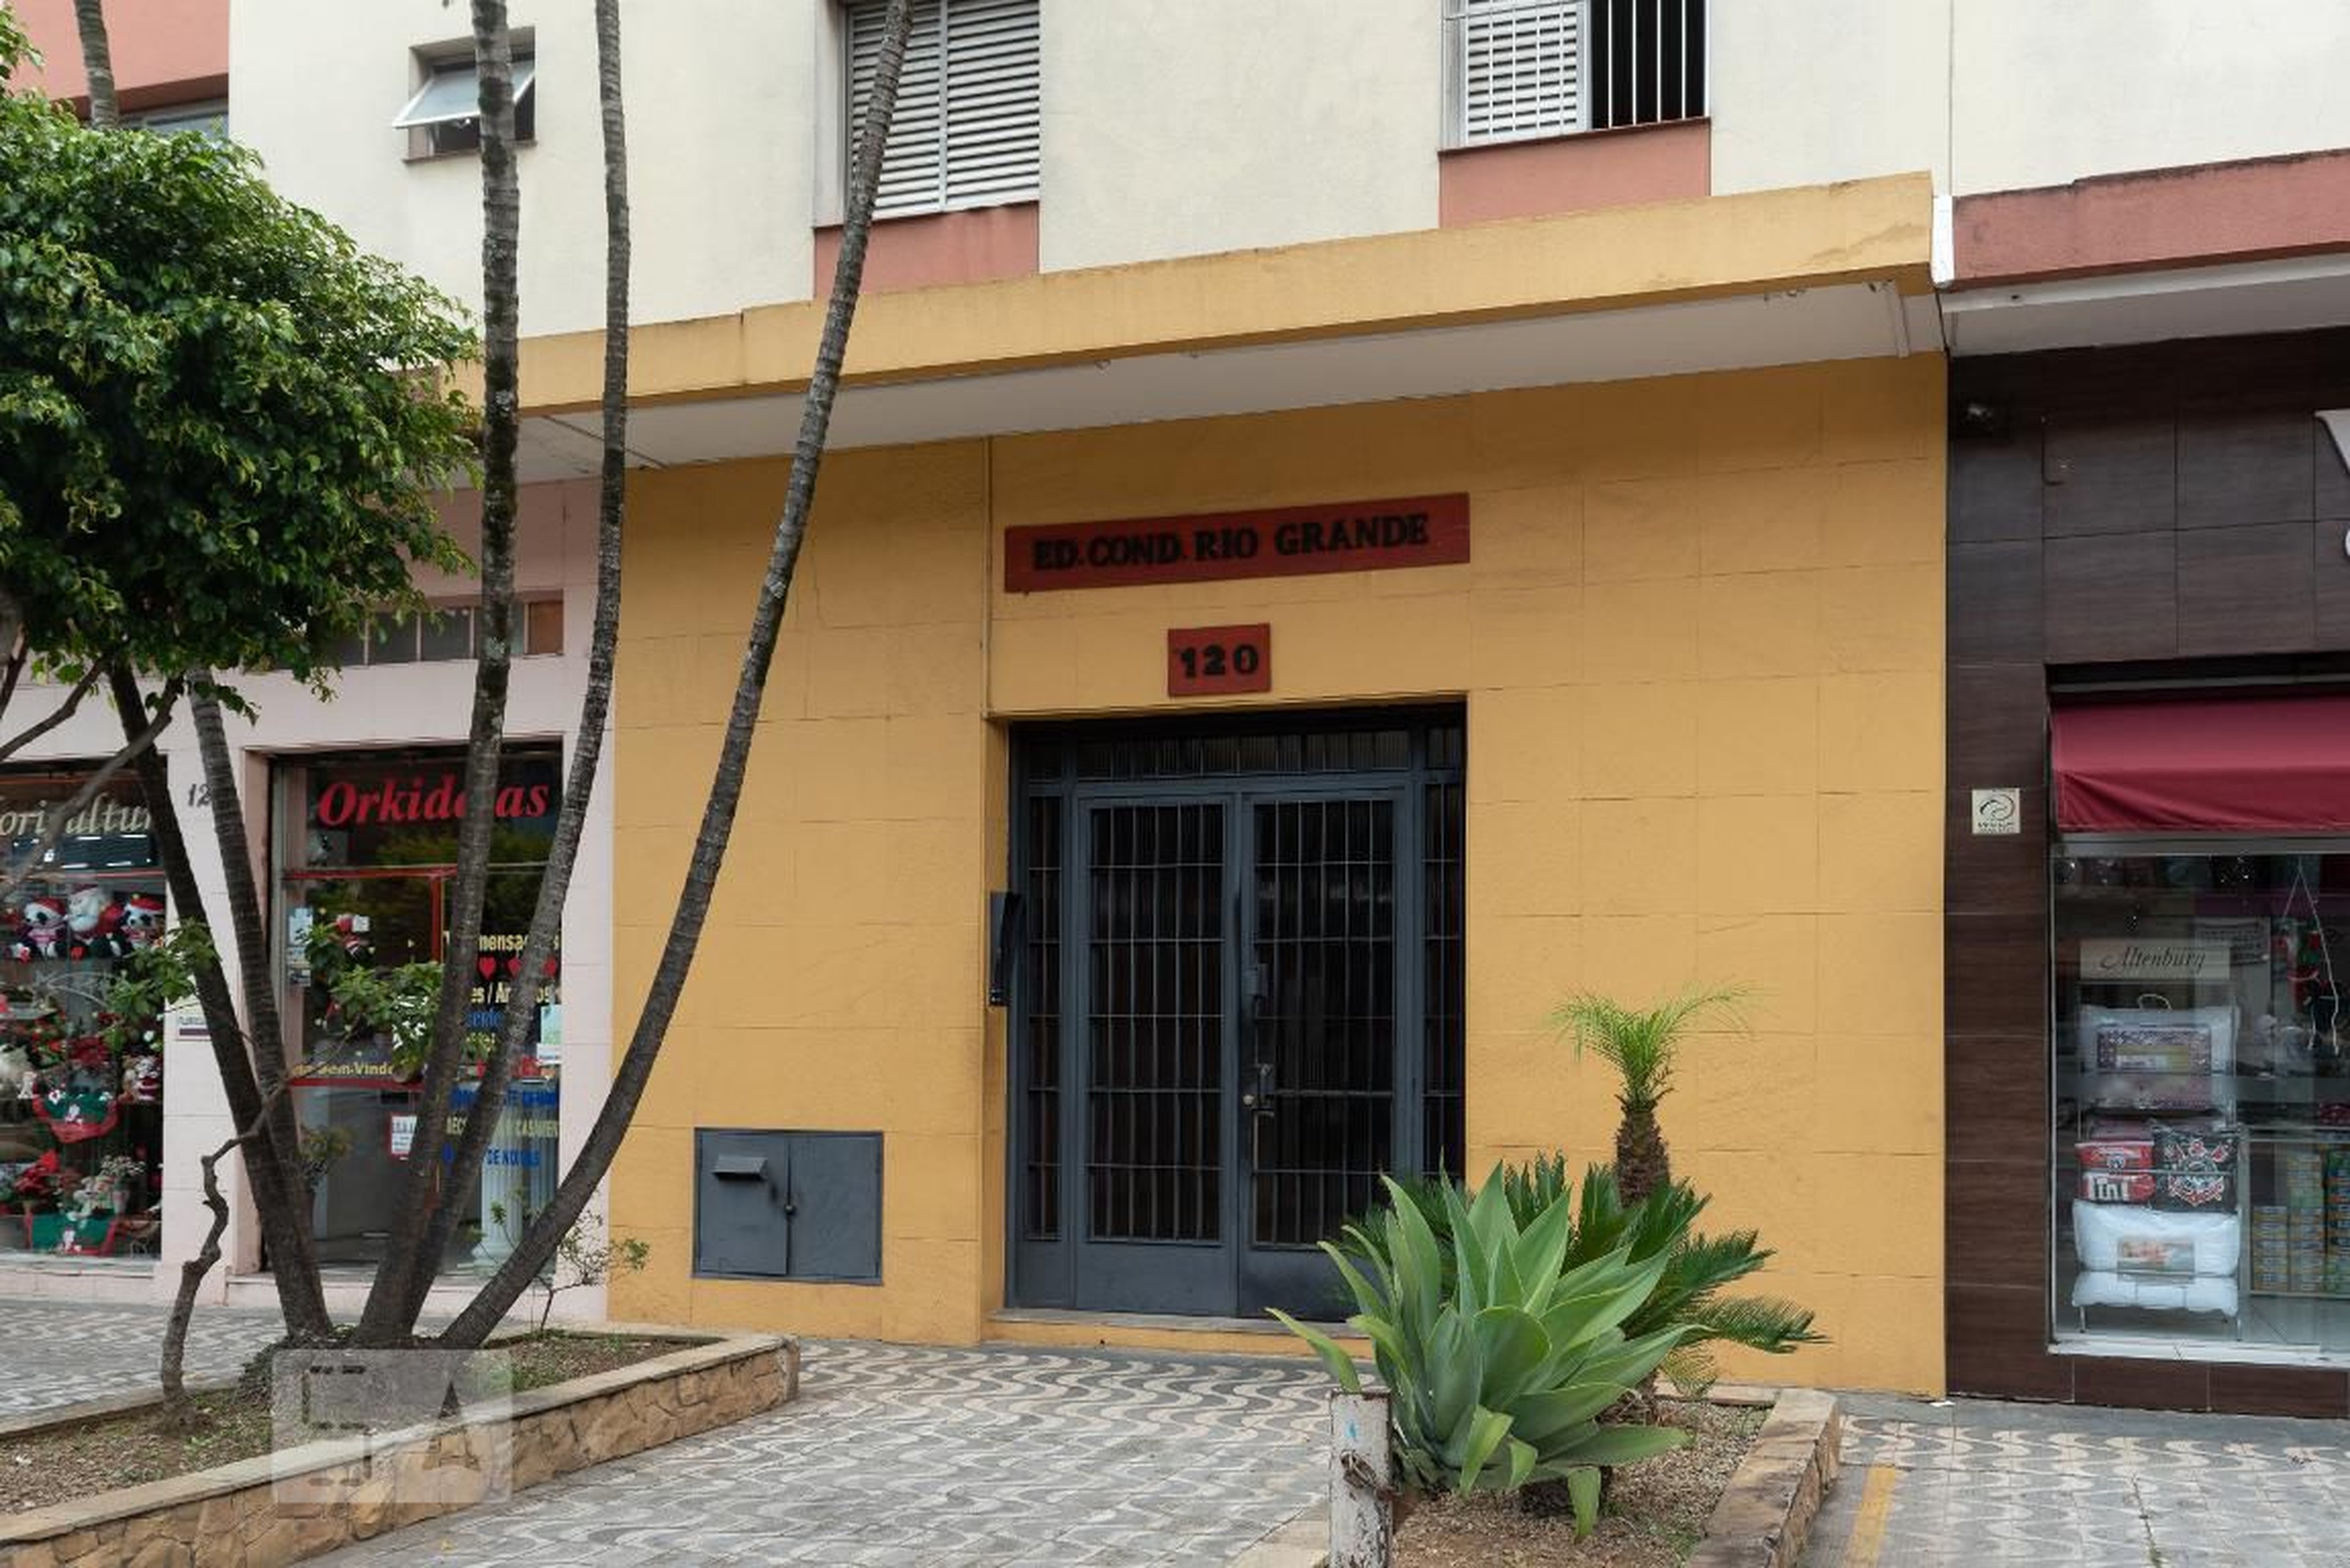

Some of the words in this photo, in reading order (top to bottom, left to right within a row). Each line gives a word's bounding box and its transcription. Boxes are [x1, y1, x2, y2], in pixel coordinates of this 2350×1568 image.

[1195, 526, 1258, 561] RIO
[1275, 513, 1428, 556] GRANDE
[1180, 644, 1259, 678] 120
